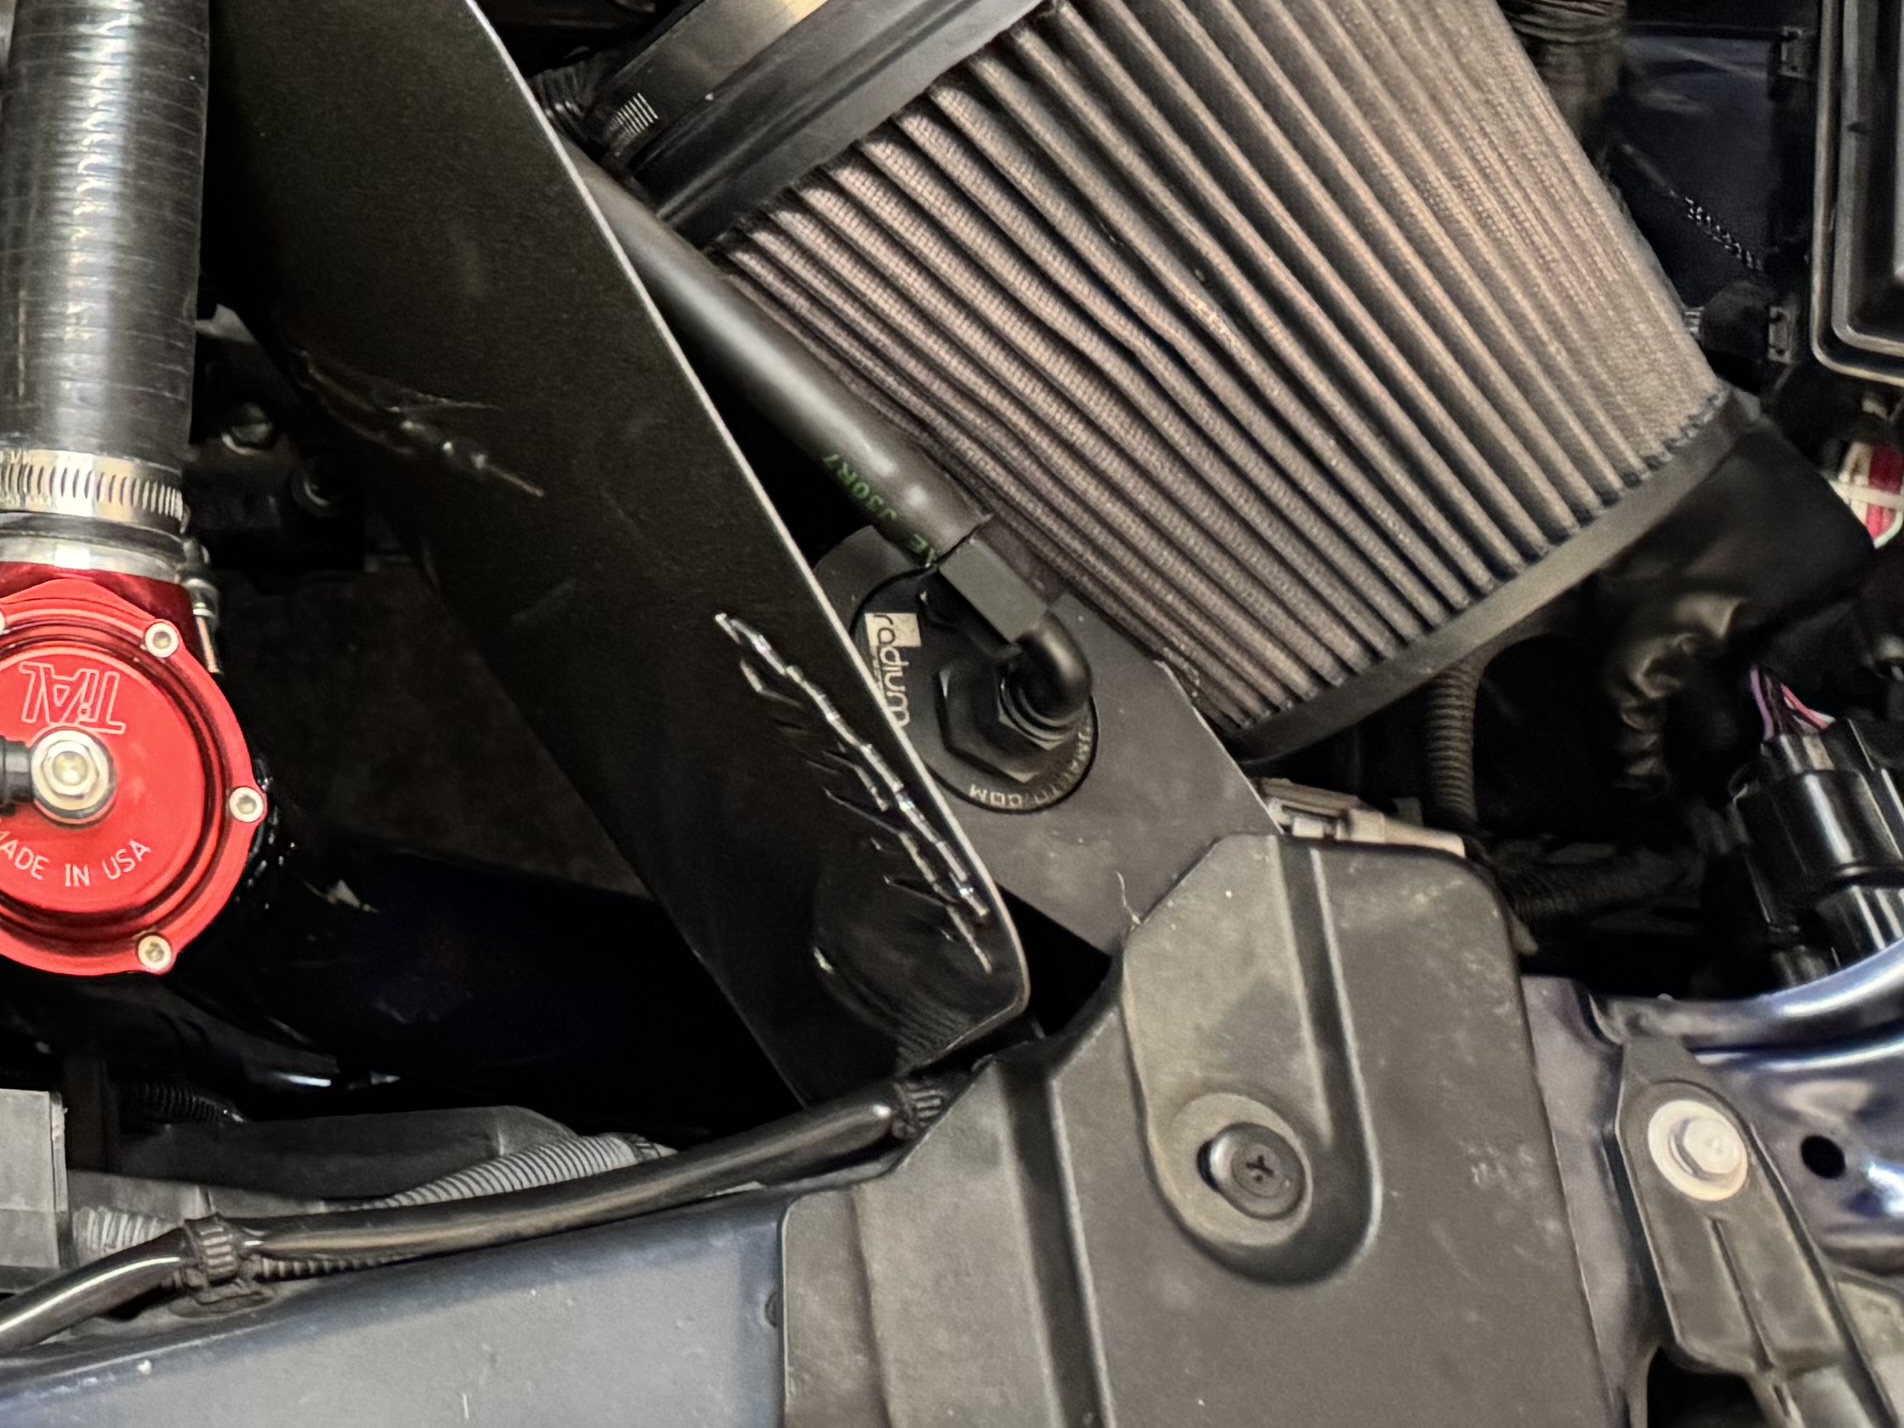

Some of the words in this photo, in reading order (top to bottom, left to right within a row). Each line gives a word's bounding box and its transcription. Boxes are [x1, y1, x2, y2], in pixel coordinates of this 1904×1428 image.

[871, 613, 910, 728] radium
[64, 863, 91, 887] IN
[101, 838, 152, 880] USA
